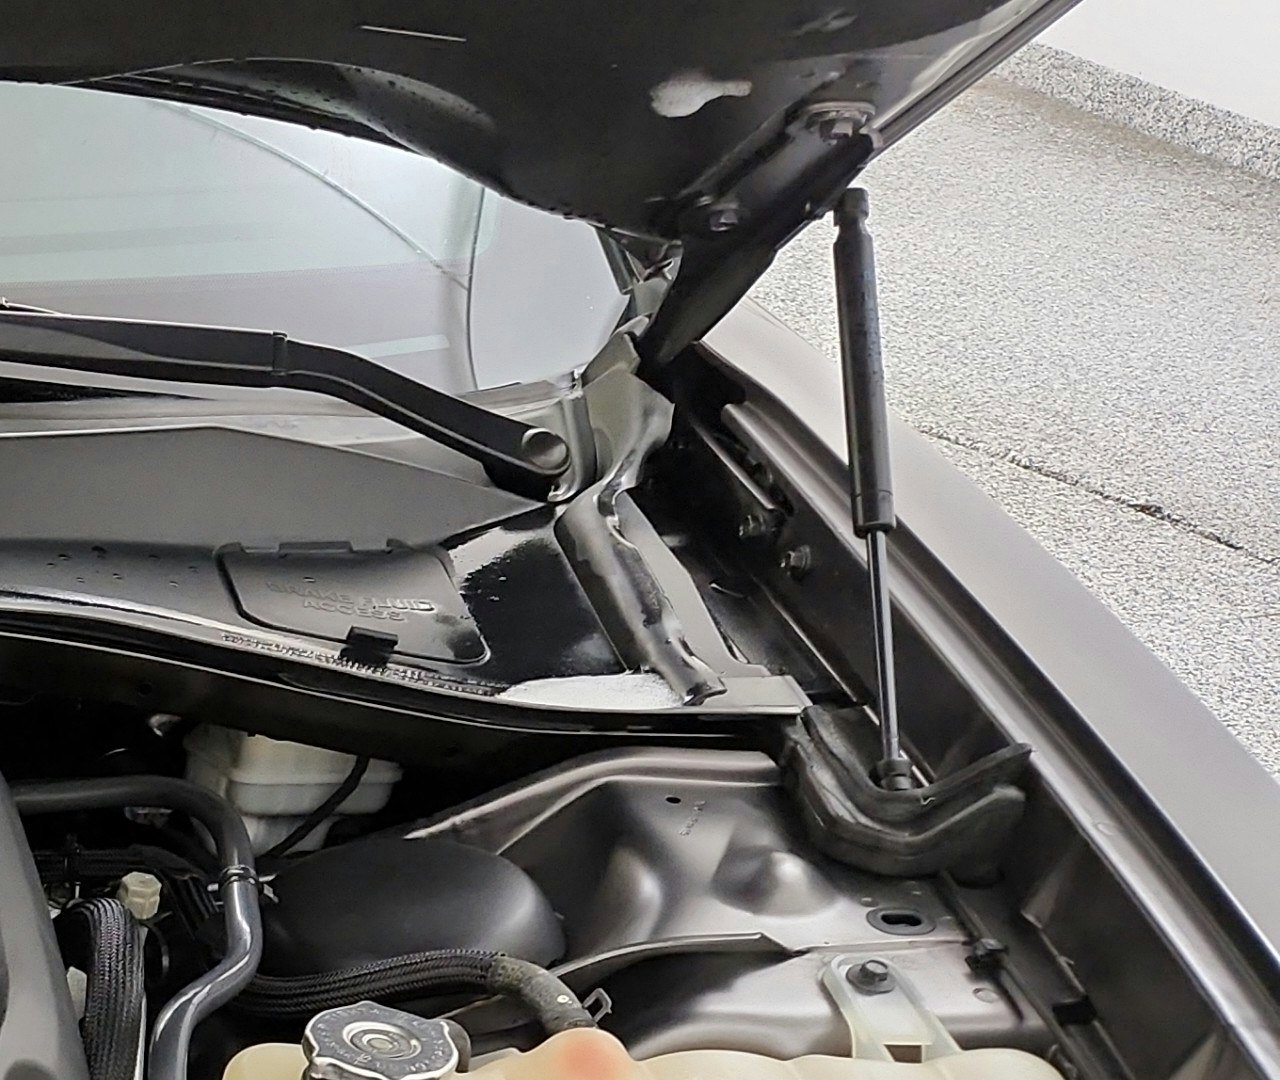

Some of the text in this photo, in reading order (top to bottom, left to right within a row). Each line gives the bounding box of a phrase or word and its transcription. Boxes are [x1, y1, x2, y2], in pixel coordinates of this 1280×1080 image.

[265, 581, 436, 612] BRAKE FLUID
[302, 598, 407, 622] ACCESS
